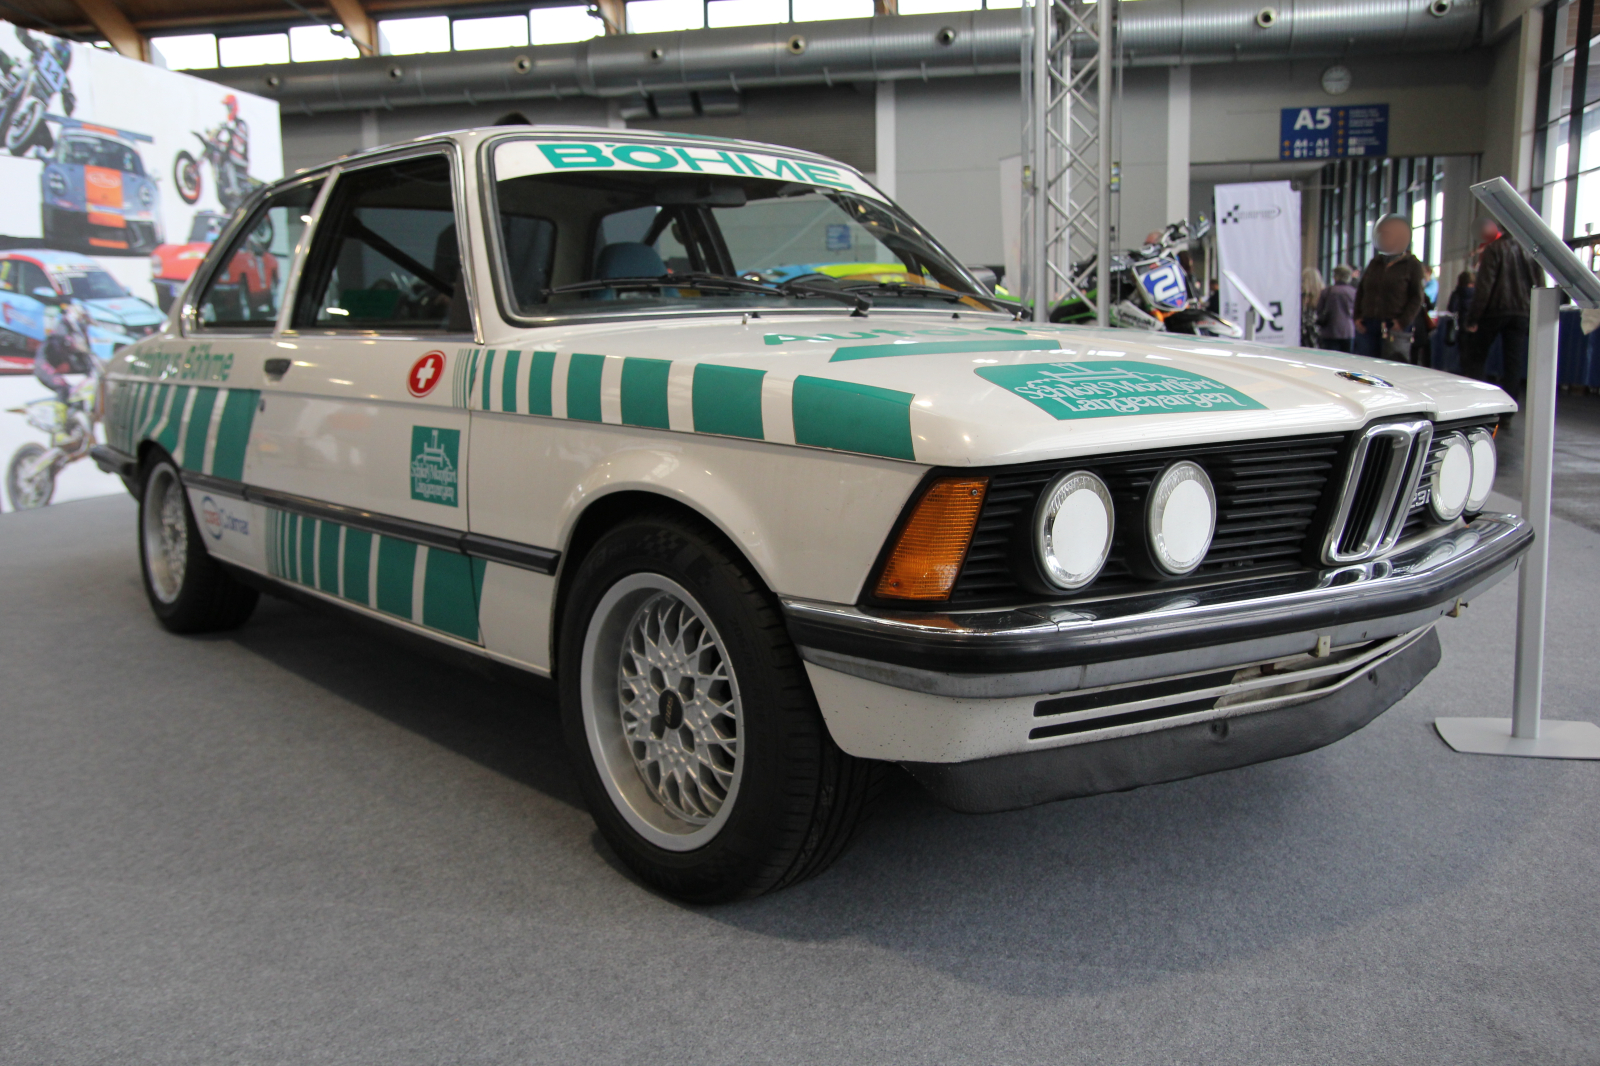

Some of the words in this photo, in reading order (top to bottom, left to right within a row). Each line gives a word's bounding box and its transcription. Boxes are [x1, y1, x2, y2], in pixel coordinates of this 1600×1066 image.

[1293, 107, 1332, 131] A5
[536, 143, 855, 190] BÖHME
[1051, 392, 1248, 413] Langenargen
